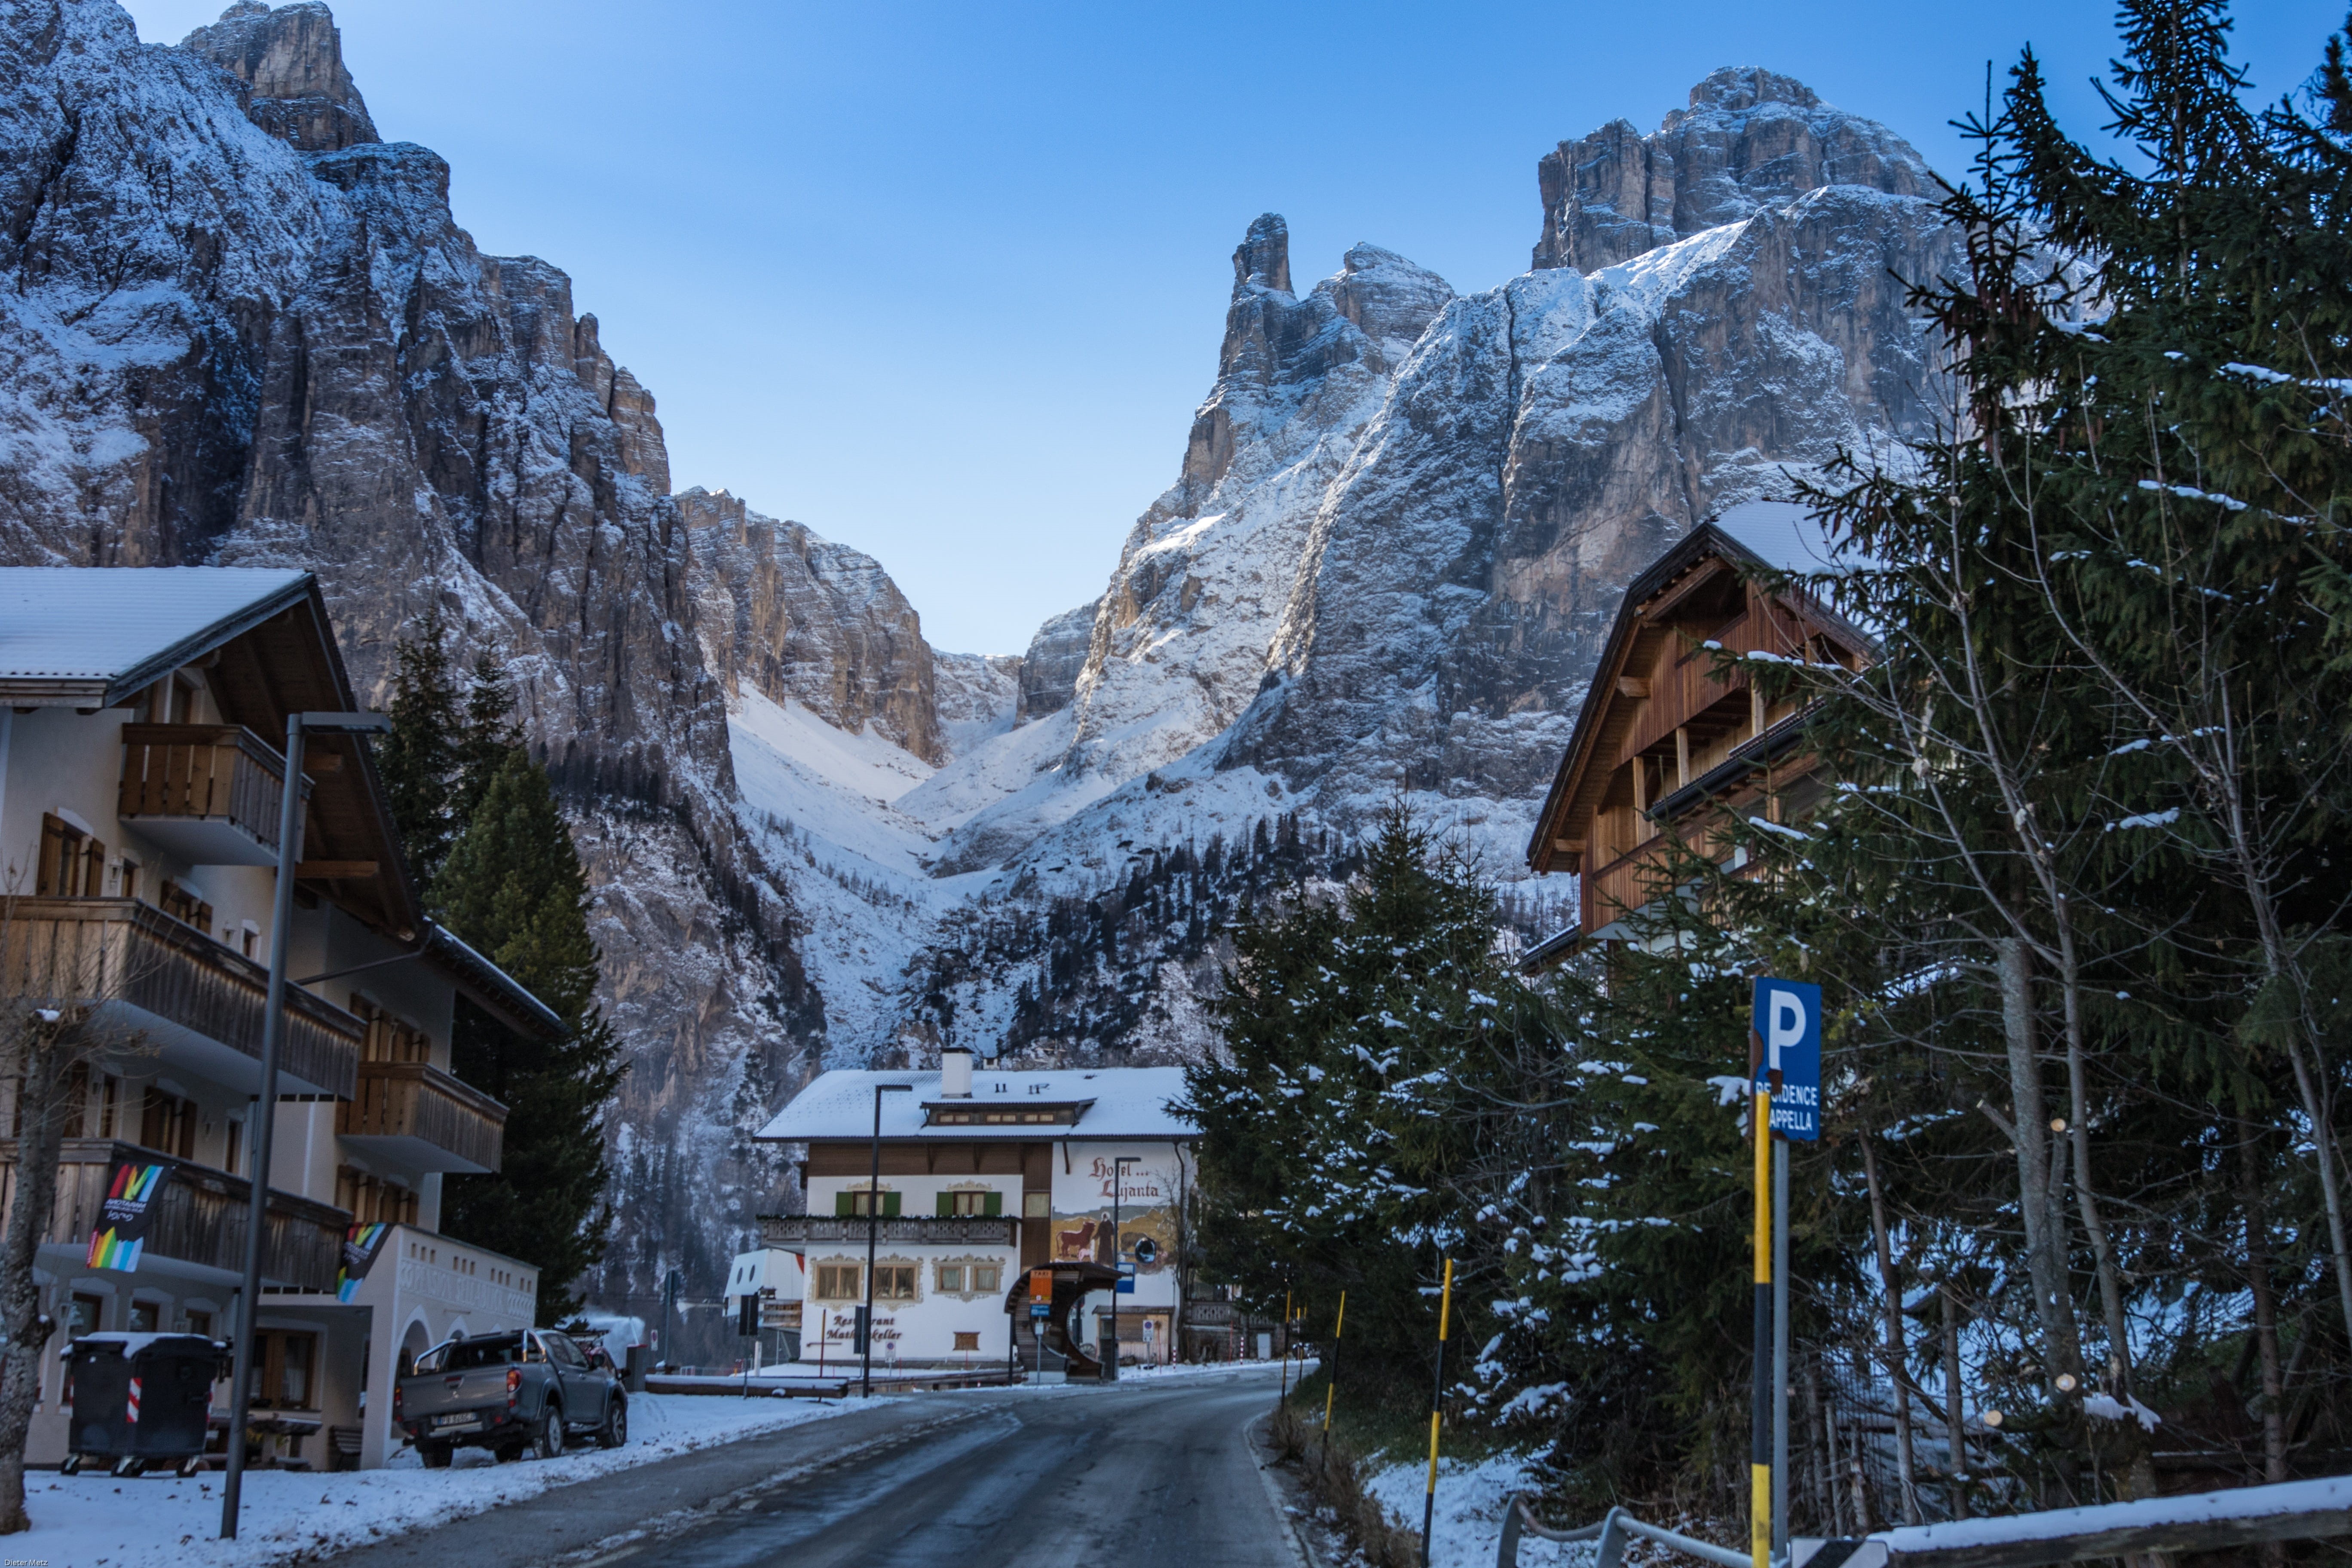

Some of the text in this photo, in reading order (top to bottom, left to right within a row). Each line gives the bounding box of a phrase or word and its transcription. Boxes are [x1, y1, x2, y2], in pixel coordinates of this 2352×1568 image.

[1769, 989, 1806, 1070] P
[1768, 1109, 1813, 1131] APPELLA
[1088, 1157, 1131, 1181] Hoel
